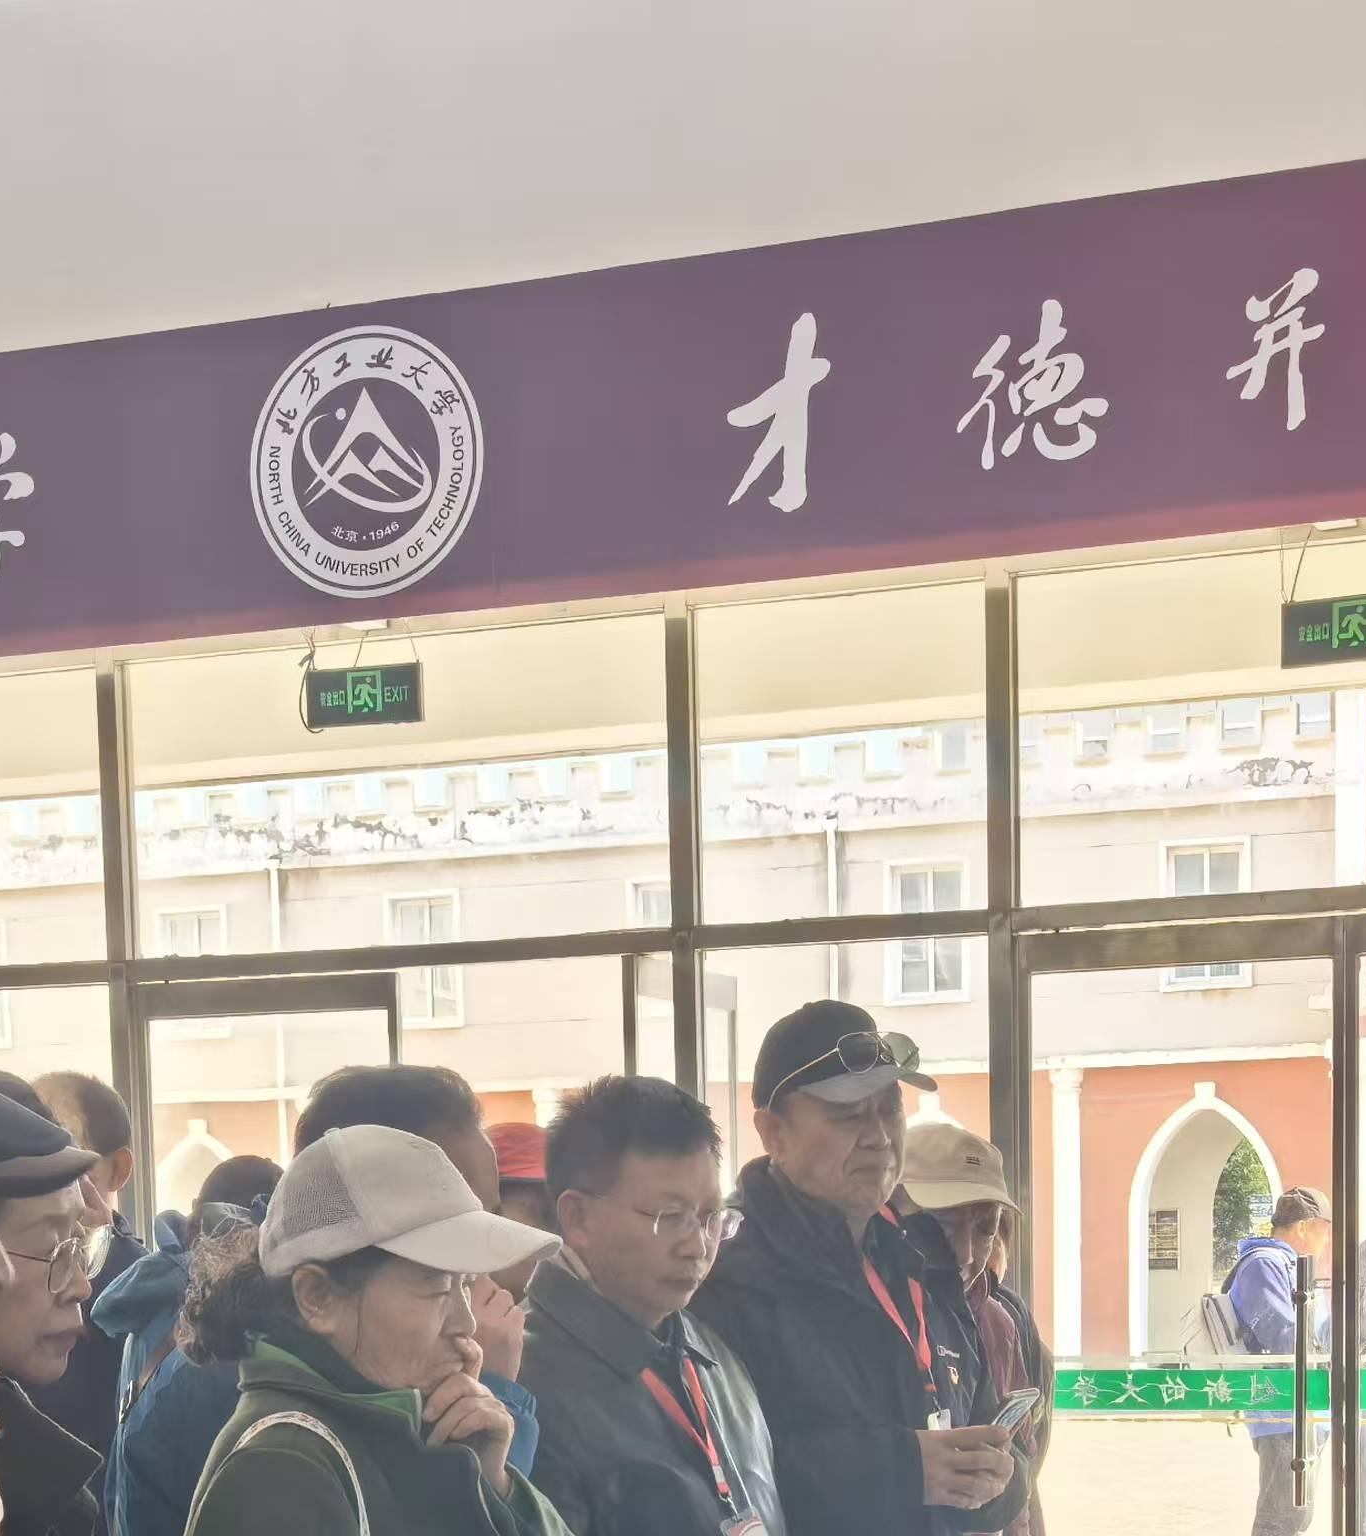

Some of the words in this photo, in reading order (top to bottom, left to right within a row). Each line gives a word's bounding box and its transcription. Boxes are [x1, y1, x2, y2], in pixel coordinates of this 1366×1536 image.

[268, 446, 284, 506] NORTH
[278, 511, 312, 557] CHINA
[315, 553, 401, 577] UNIVERSITY
[406, 537, 426, 559] OF
[425, 425, 465, 538] TECHNOLOGY
[384, 685, 410, 702] EXIT
